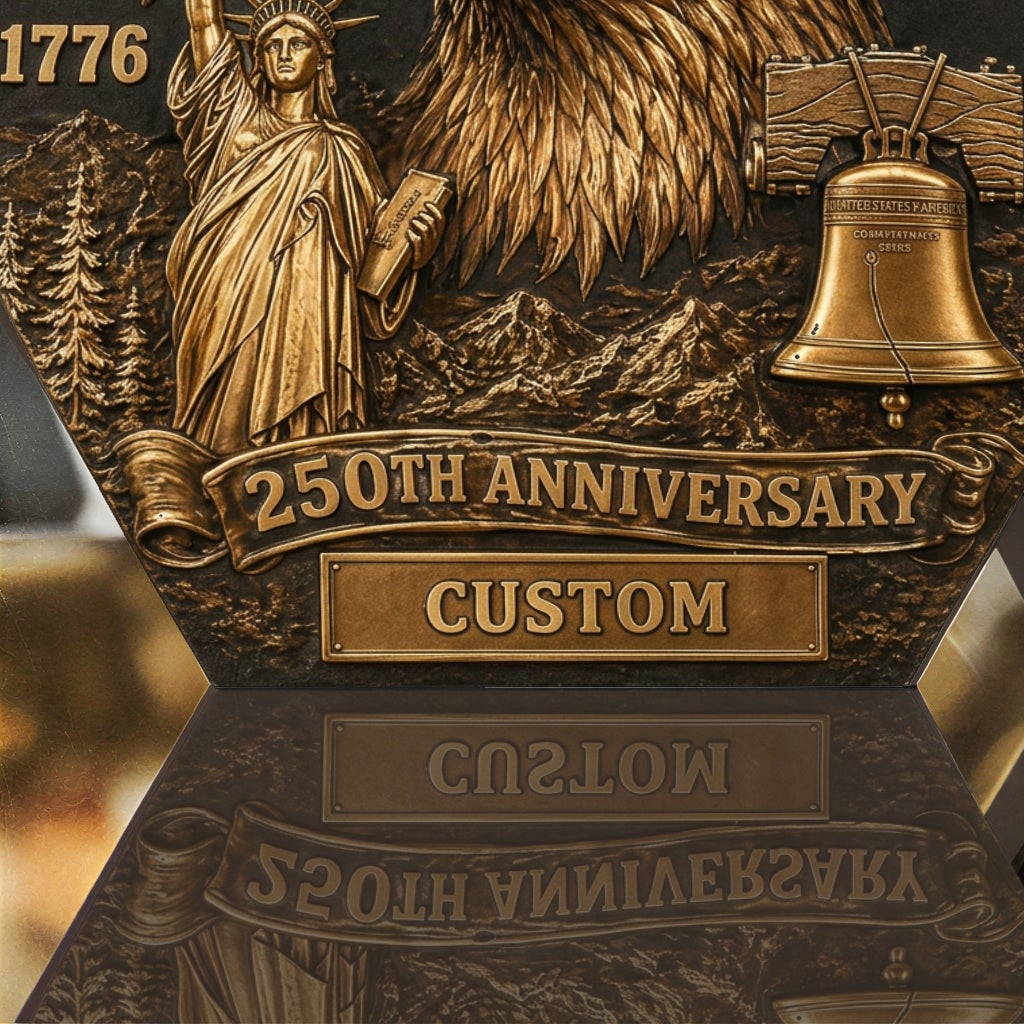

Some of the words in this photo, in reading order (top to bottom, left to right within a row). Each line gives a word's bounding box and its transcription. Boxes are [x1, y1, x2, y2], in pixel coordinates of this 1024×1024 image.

[0, 24, 148, 84] 1776
[244, 451, 466, 533] 250TH
[482, 453, 928, 530] ANNIVERSARY
[424, 580, 730, 636] CUSTOM
